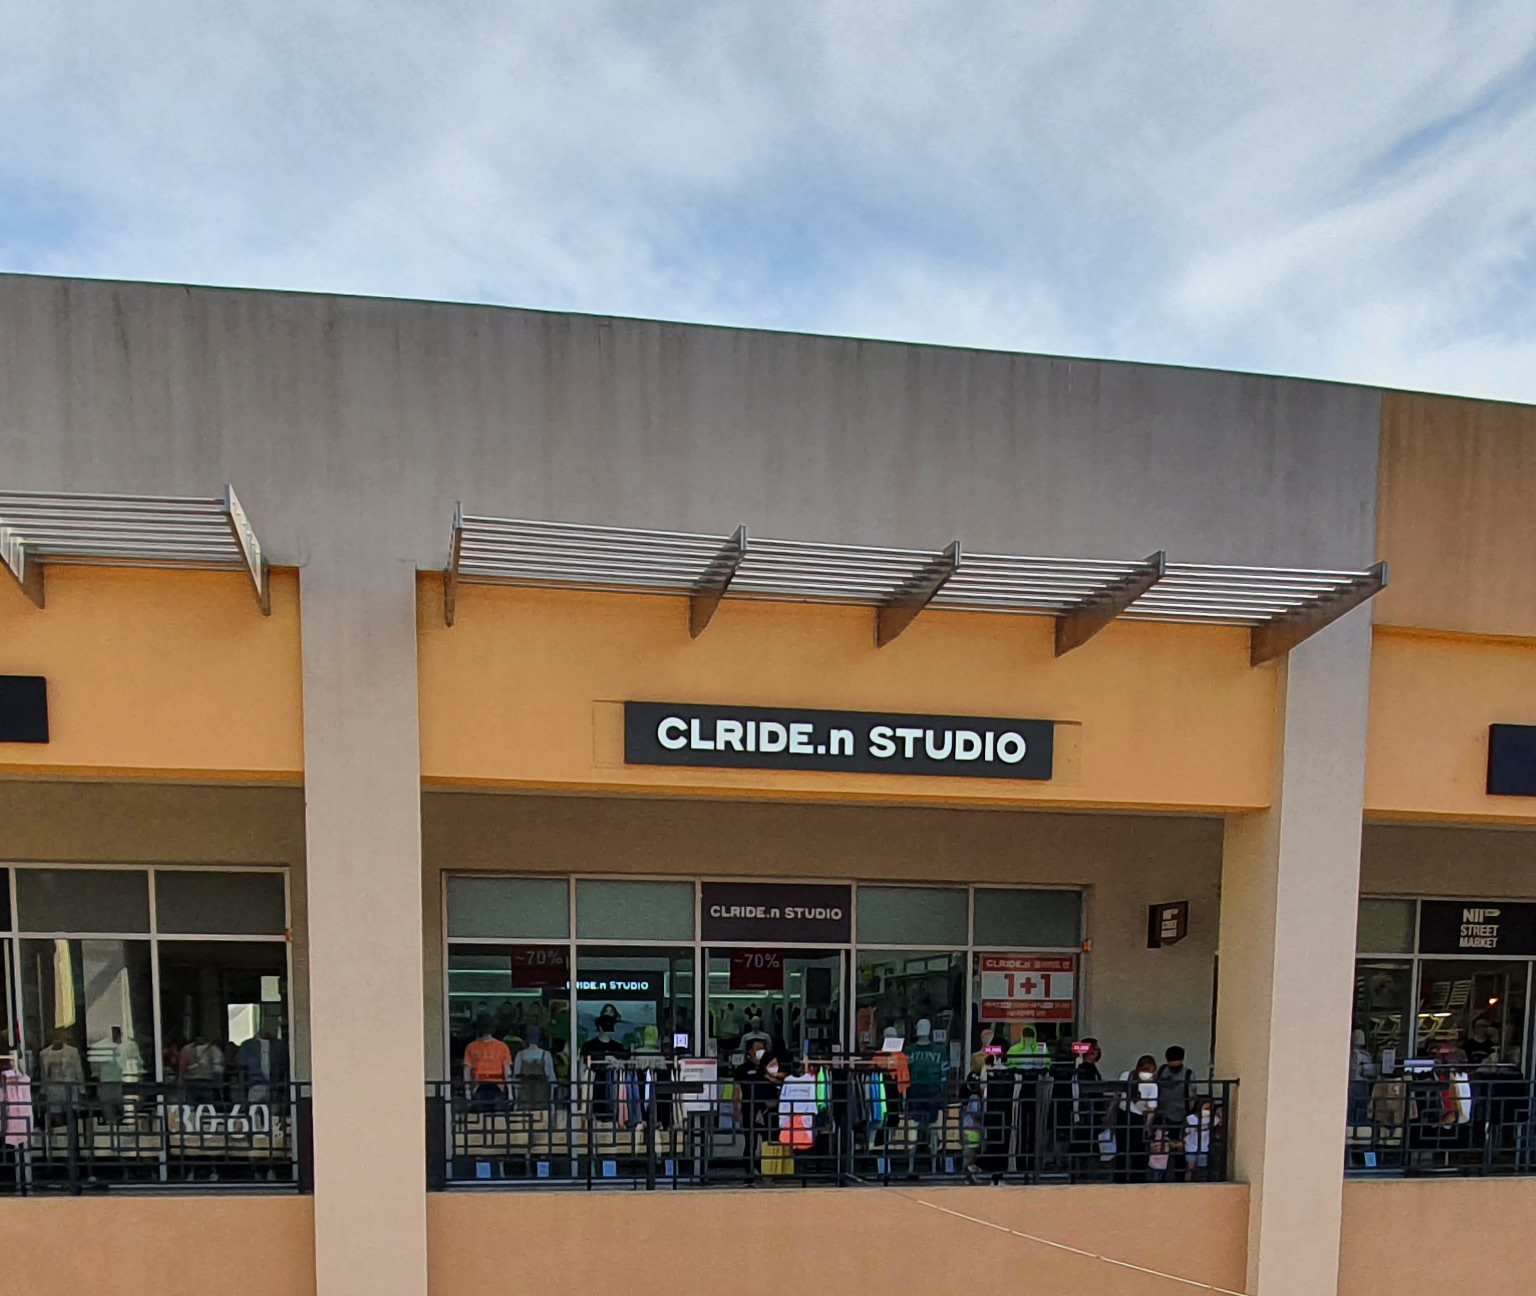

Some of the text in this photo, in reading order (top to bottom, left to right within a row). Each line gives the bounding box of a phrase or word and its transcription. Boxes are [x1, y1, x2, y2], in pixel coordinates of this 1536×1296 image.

[657, 717, 1026, 763] CLRIDE.n STUDIO
[710, 906, 843, 920] CLRIDE.n STUDIO
[1462, 908, 1484, 923] NII
[1460, 924, 1500, 937] STREET
[1458, 937, 1498, 949] MARKET
[609, 981, 649, 990] STUDIO
[1004, 973, 1052, 998] 1+1
